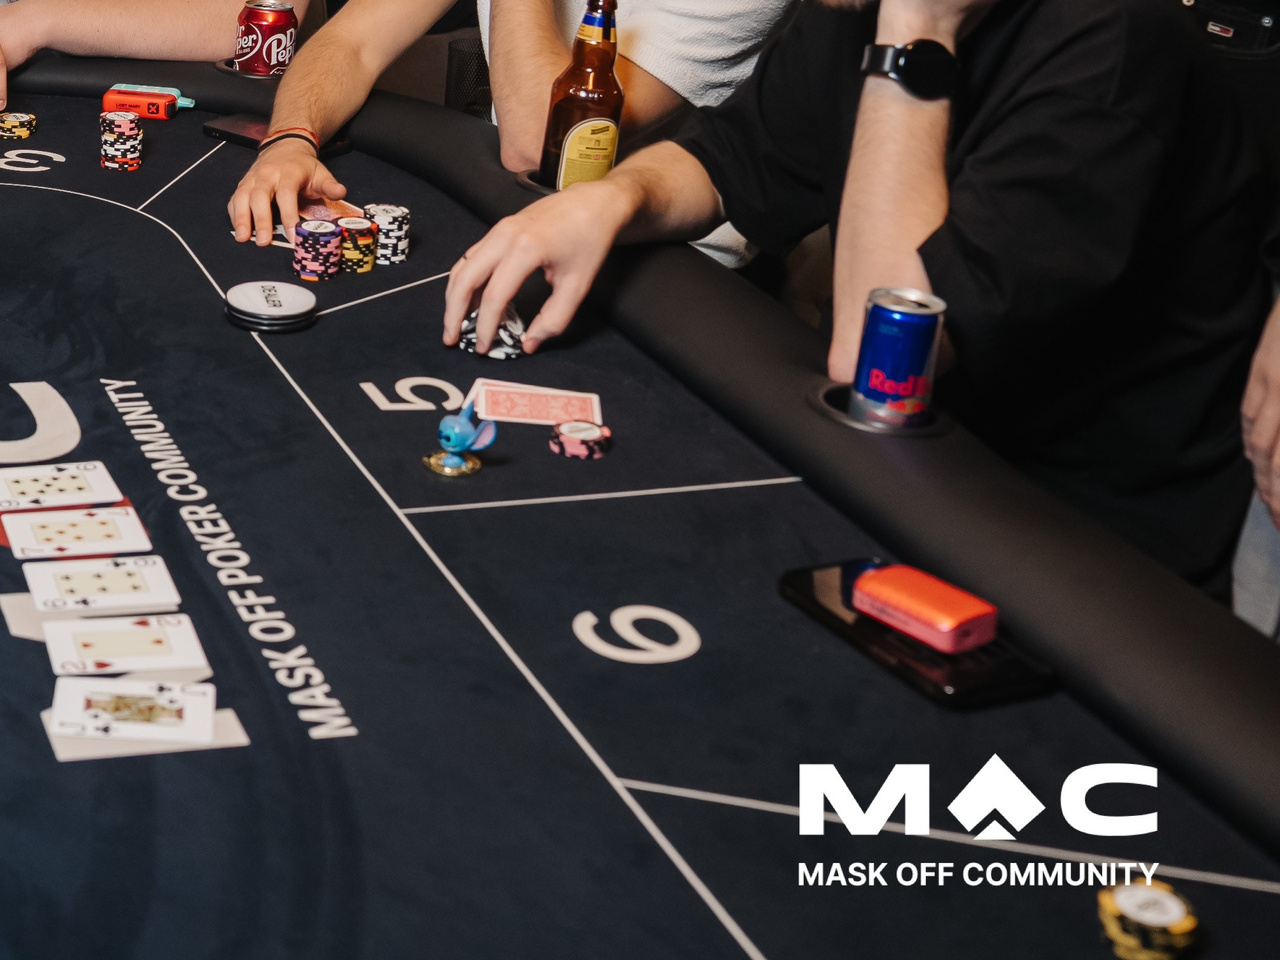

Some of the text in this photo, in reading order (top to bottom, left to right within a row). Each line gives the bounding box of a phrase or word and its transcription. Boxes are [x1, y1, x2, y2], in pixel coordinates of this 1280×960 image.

[360, 376, 464, 413] 5
[869, 368, 914, 397] Red
[99, 378, 359, 740] MASK OFF POKER COMMUNITY
